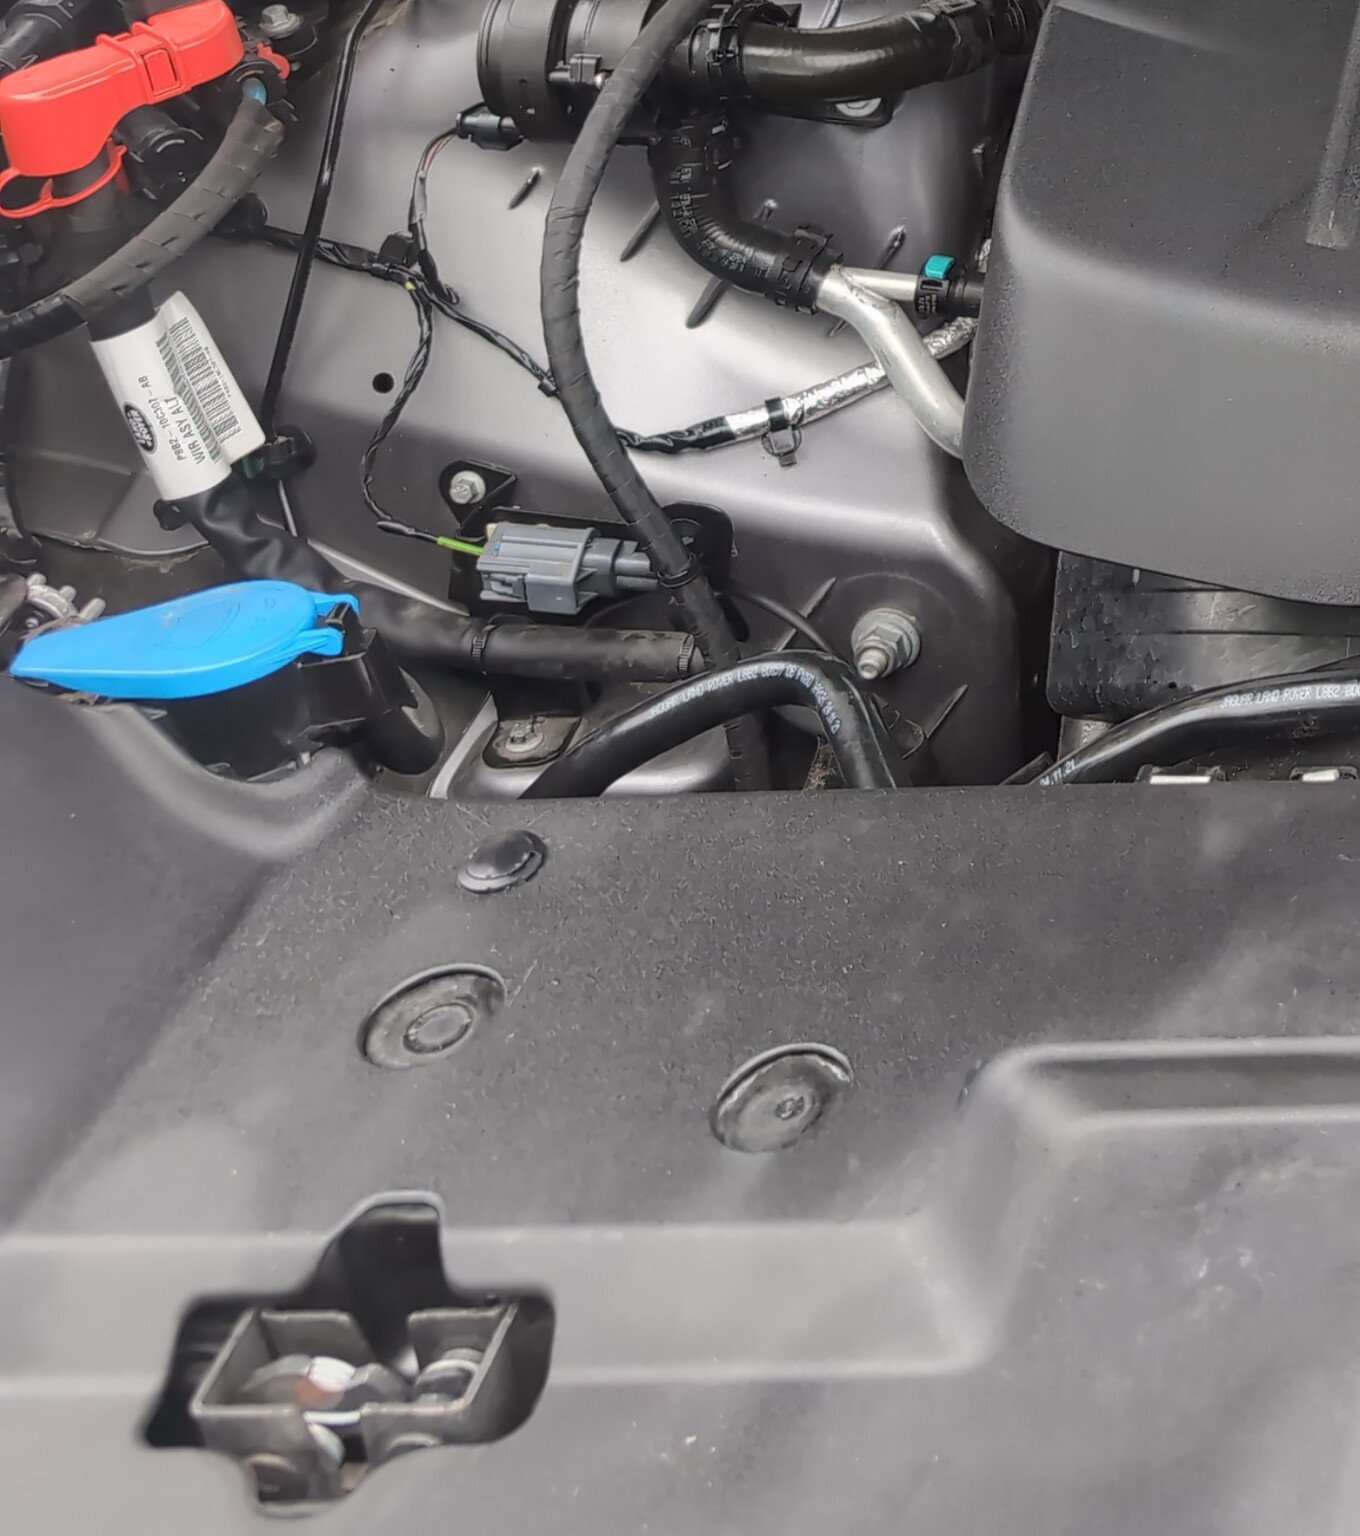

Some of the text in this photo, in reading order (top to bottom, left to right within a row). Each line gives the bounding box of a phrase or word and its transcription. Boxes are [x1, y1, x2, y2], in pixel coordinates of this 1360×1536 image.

[163, 396, 206, 464] WIR ASY ALT
